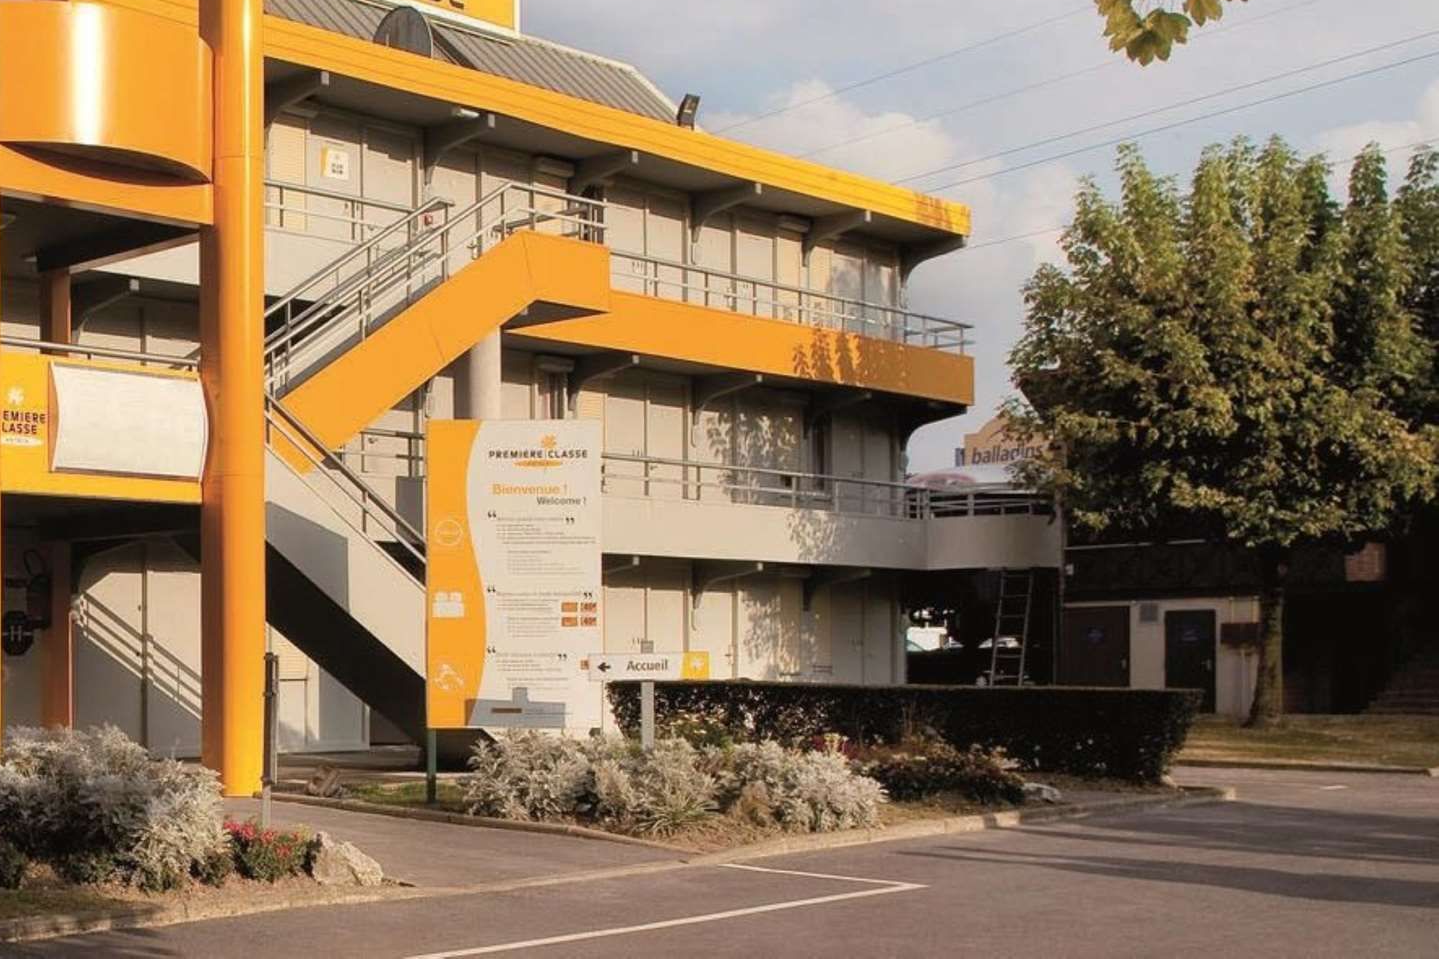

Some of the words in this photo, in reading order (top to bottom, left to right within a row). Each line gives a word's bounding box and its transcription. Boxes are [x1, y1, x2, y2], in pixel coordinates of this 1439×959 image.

[1, 422, 37, 434] LASSE
[547, 449, 588, 458] CLASSE
[492, 483, 560, 495] Bienvenue
[536, 497, 580, 506] Welcome
[626, 659, 669, 672] Accueil
